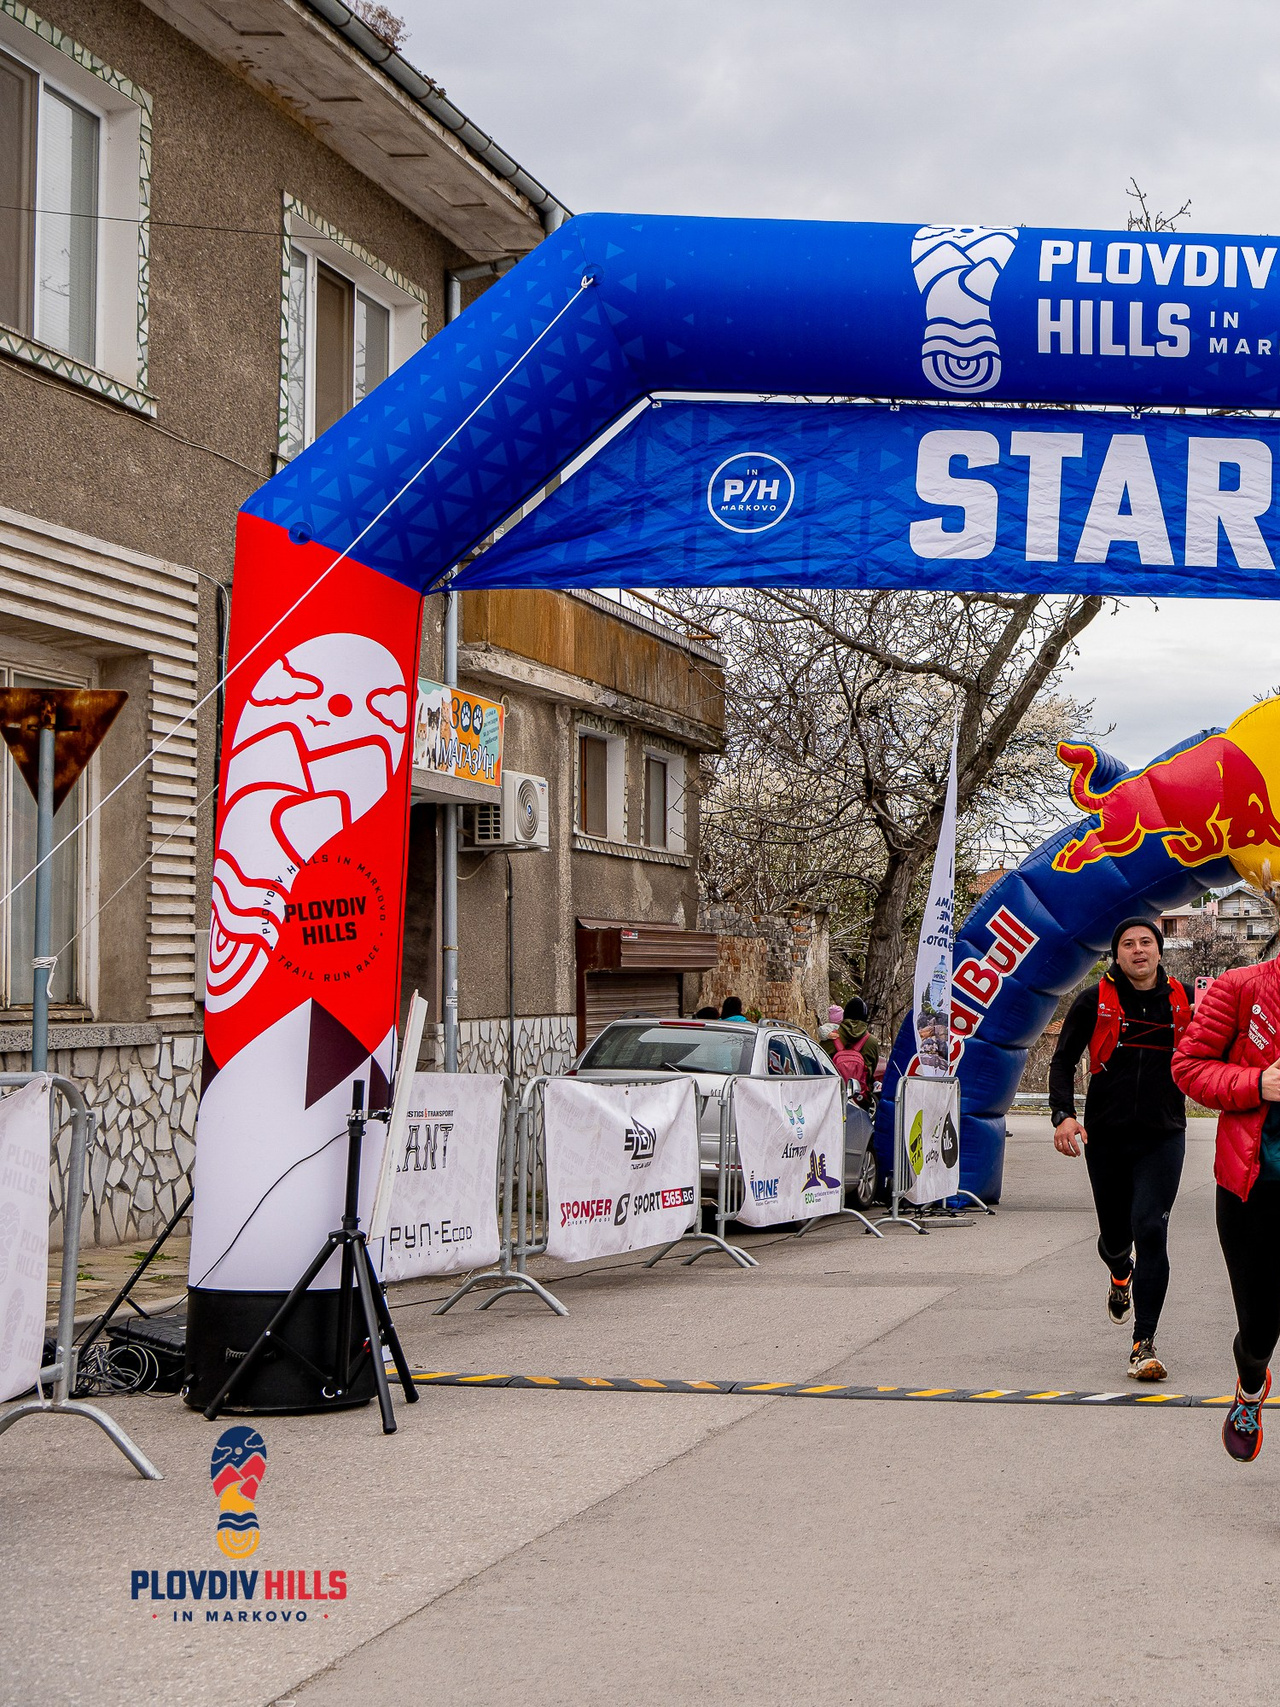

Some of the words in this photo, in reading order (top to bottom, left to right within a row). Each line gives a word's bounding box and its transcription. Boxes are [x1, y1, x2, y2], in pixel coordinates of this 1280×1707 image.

[1039, 240, 1278, 289] PLOVDIV
[1037, 298, 1191, 358] HILLS
[1210, 311, 1239, 328] IN
[746, 468, 758, 476] IN
[723, 479, 780, 503] P/H
[720, 504, 777, 512] MARKOVO
[440, 737, 494, 780] МАГАЗИН
[261, 875, 284, 935] PLOVDIV
[287, 855, 329, 875] HILLS
[357, 863, 386, 921] MARKOVO
[284, 896, 367, 923] PLOVDIV
[302, 922, 357, 946] HILLS
[278, 955, 314, 981] TRAIL
[323, 970, 351, 982] RUN
[356, 945, 380, 973] RACE
[952, 906, 1038, 1007] Bull
[428, 1109, 454, 1118] TRANSPORT
[560, 1199, 612, 1228] SPONSER
